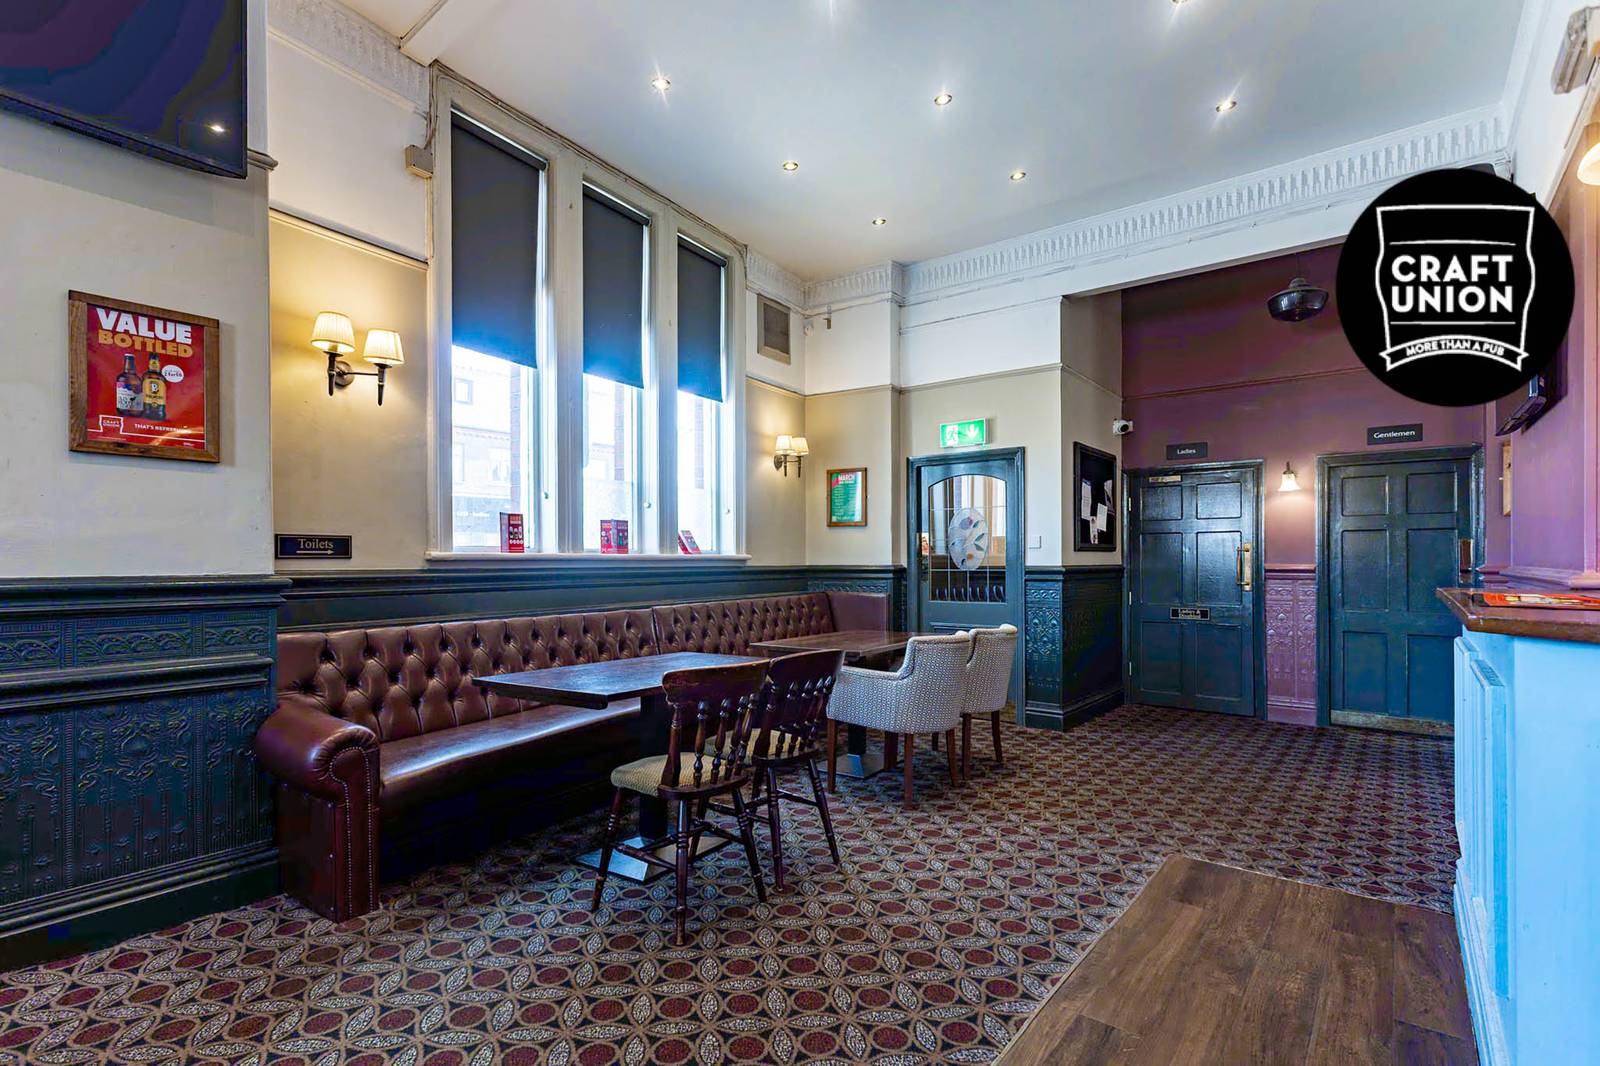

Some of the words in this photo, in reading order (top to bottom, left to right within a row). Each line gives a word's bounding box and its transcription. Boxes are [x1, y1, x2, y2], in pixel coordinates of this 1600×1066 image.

[97, 308, 192, 344] VALUE
[98, 329, 193, 358] BOTTLED
[1373, 430, 1416, 439] Gentlemen
[297, 538, 334, 549] Toilets
